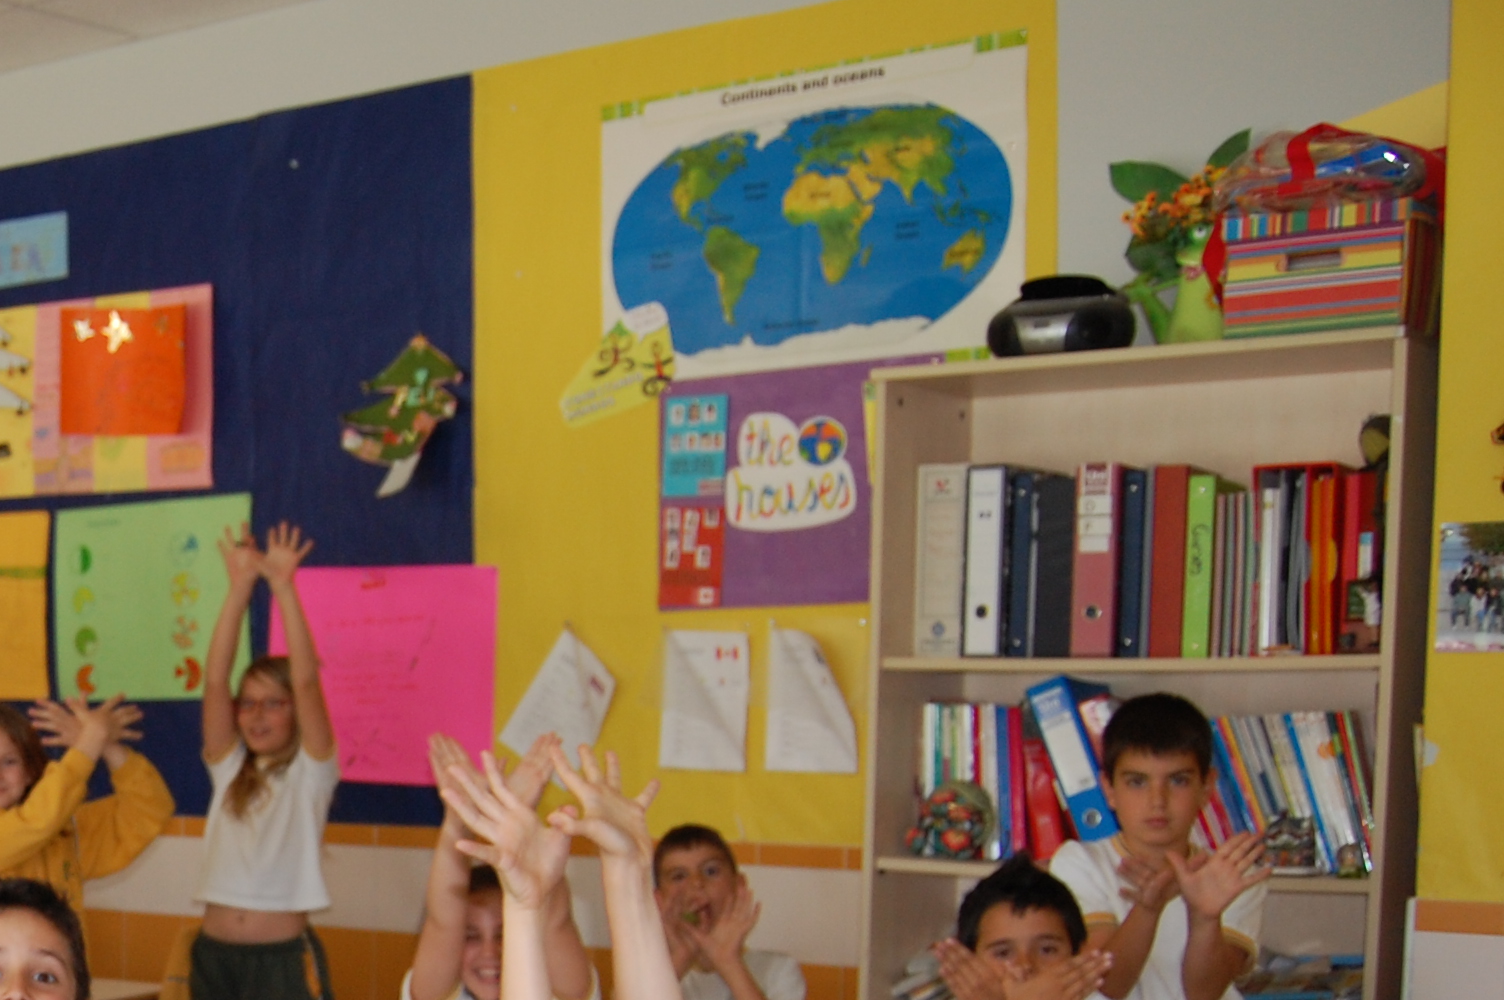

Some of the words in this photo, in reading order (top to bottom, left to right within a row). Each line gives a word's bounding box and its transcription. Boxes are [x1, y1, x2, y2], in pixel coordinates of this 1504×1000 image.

[721, 83, 797, 105] Continents
[802, 76, 829, 91] and
[833, 66, 886, 85] oceans
[746, 419, 795, 466] the
[733, 470, 851, 523] houses
